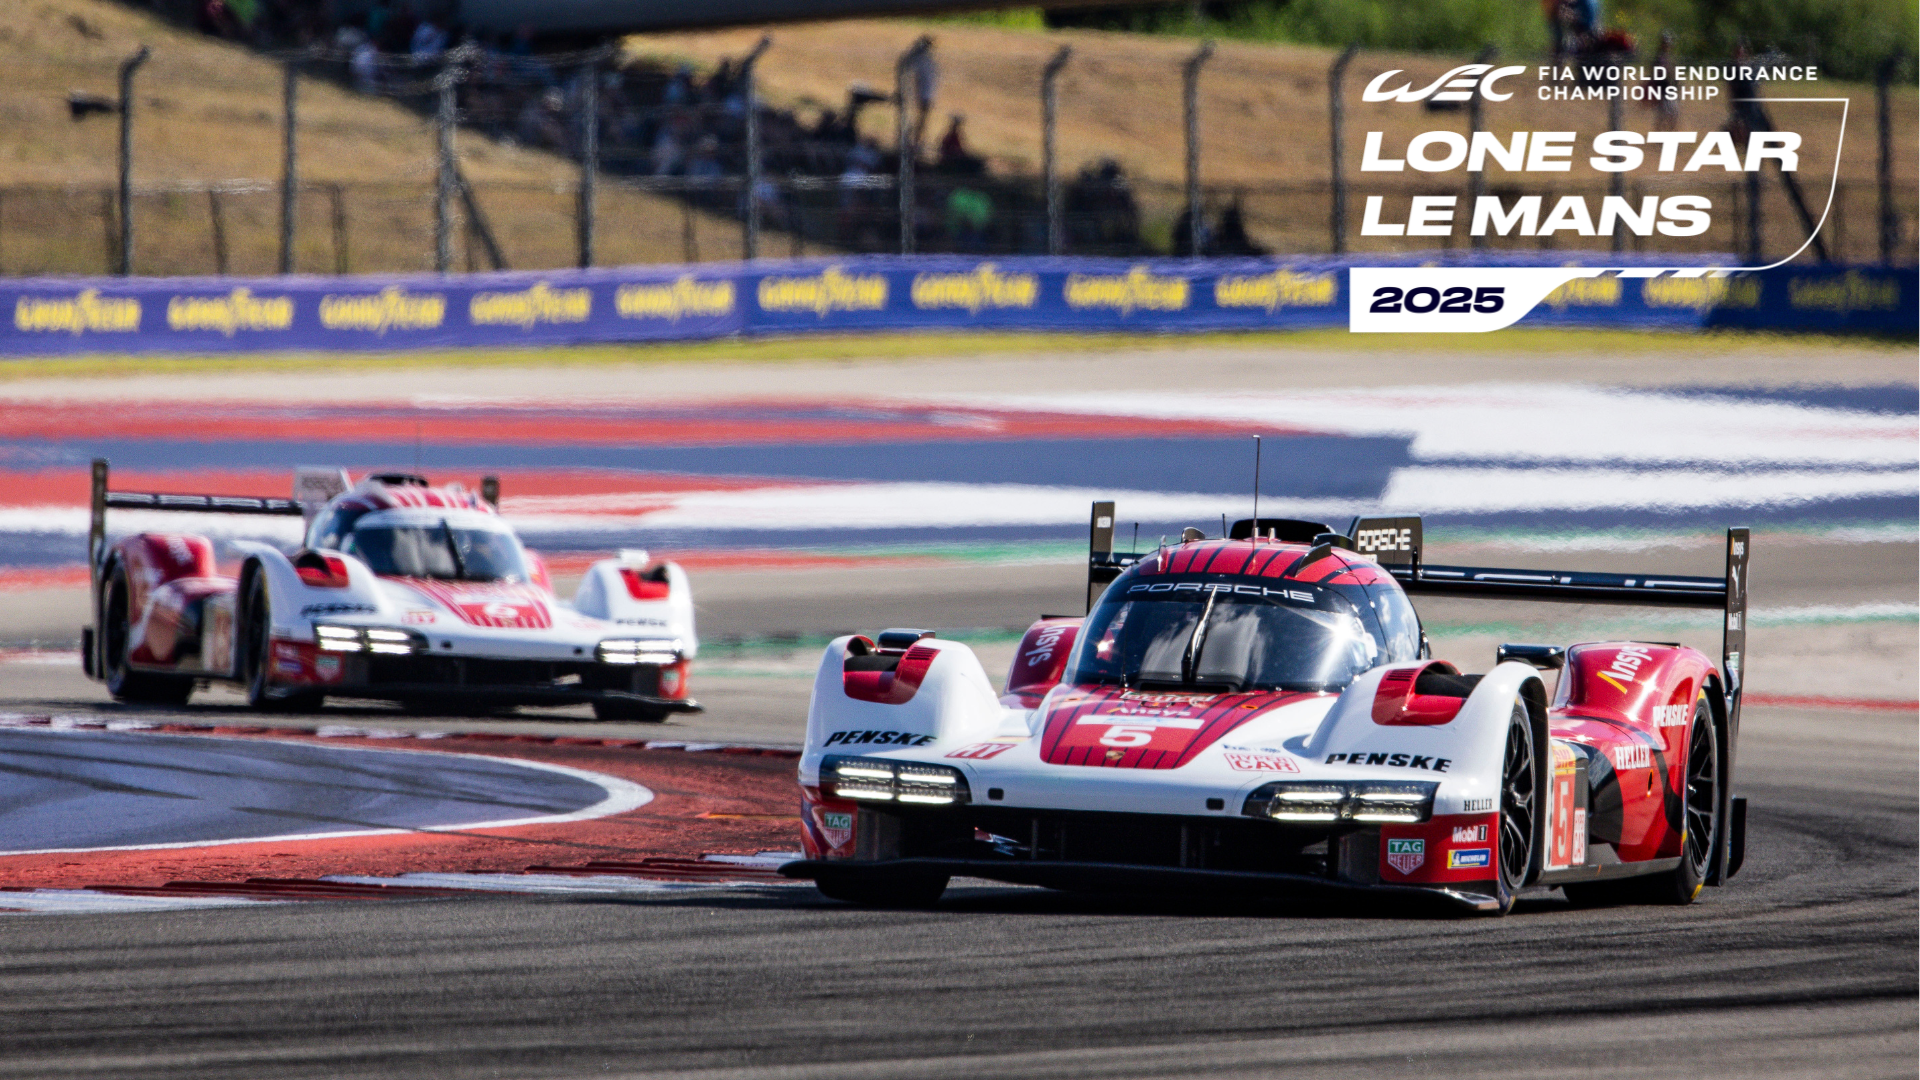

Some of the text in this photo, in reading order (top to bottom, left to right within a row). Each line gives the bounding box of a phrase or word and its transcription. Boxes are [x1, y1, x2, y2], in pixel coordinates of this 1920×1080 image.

[1127, 583, 1315, 602] PORSCHE
[1596, 646, 1652, 694] Ansys
[1653, 704, 1688, 727] PENSKE
[823, 731, 937, 747] PENSKE
[1100, 726, 1156, 747] 5
[1234, 760, 1294, 771] CAR
[1325, 753, 1452, 772] PENSKE
[1614, 745, 1650, 769] HELLER
[1463, 799, 1492, 811] HELLER
[826, 816, 849, 827] TAG
[1558, 781, 1568, 858] 5
[1452, 826, 1478, 843] Mobil
[1391, 841, 1422, 852] TAG
[1390, 854, 1422, 872] HEUER
